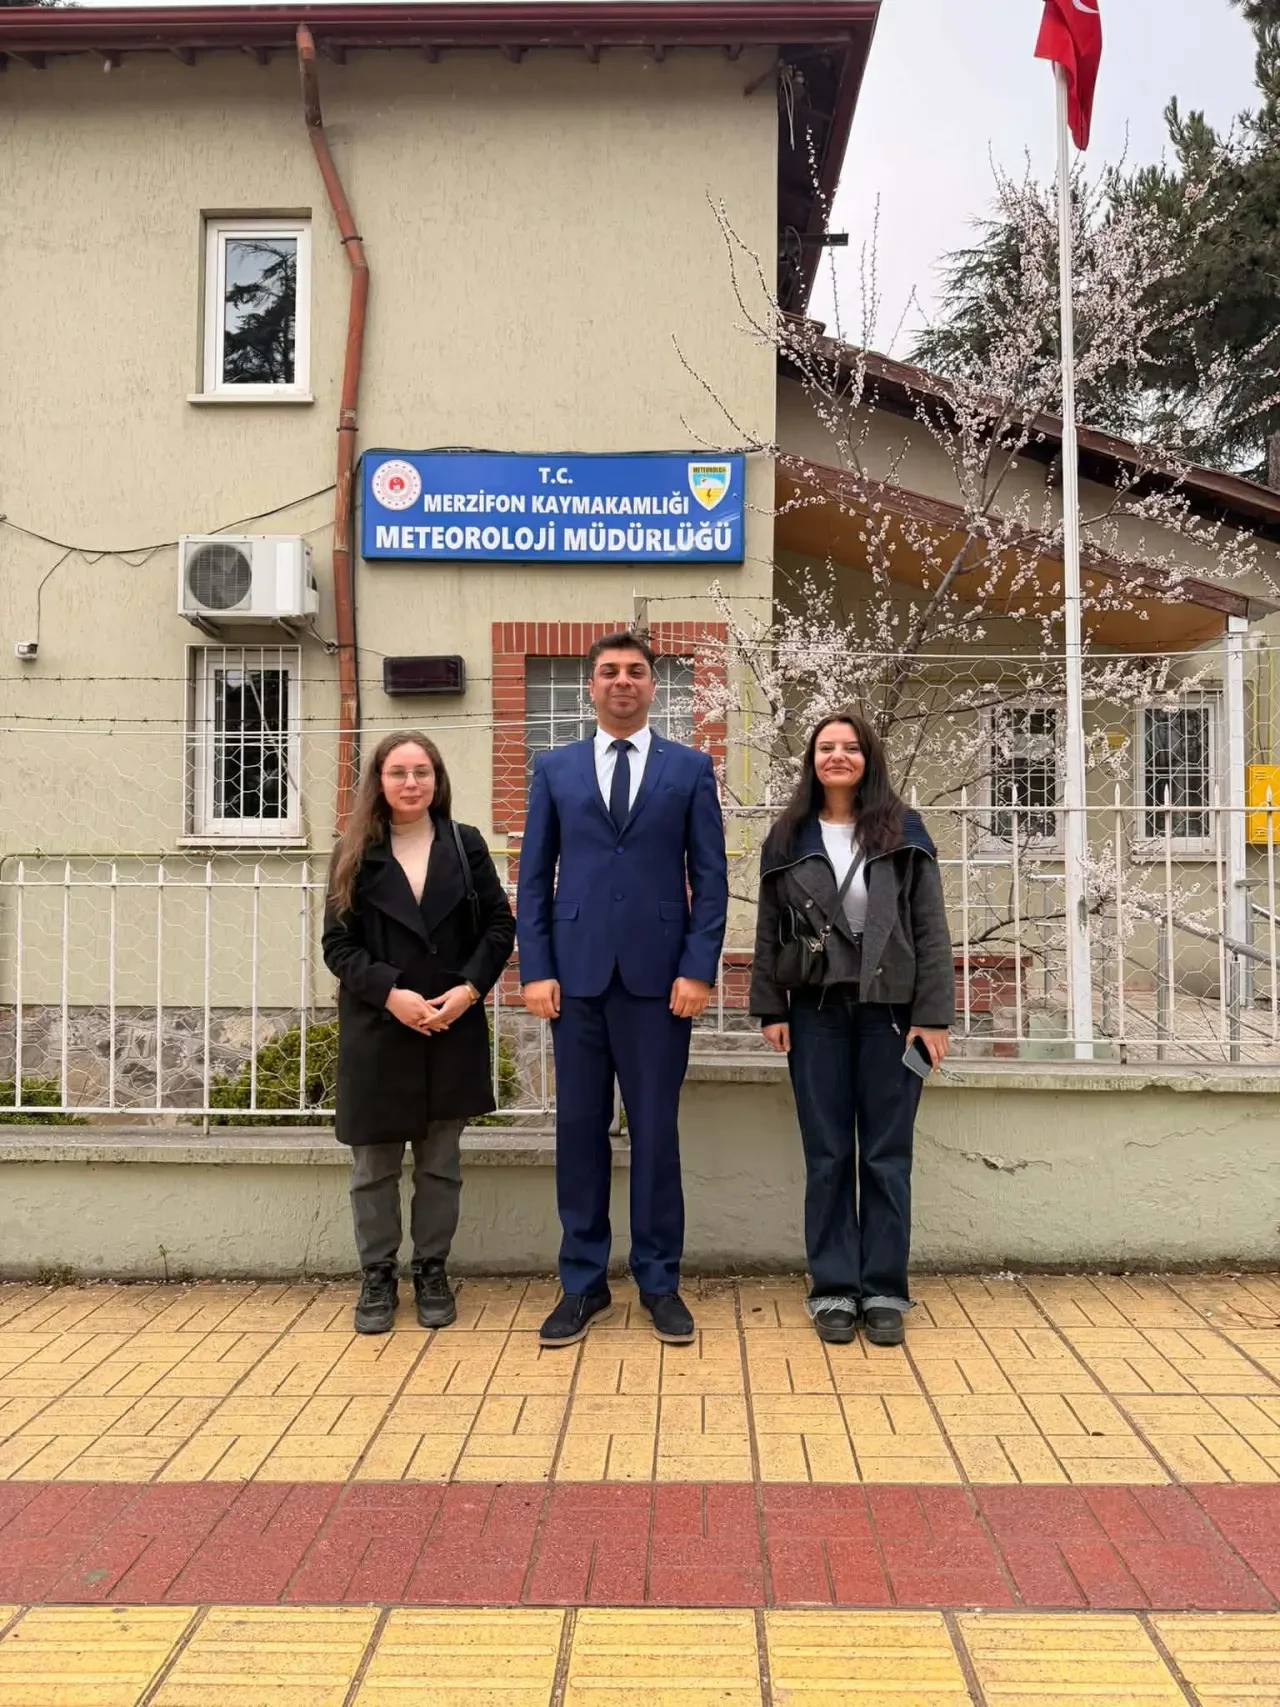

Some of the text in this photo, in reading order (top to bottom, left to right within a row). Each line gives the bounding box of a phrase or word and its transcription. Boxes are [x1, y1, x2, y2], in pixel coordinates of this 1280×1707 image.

[539, 467, 573, 484] T.C.
[424, 490, 688, 514] MERZİFON KAYMAKAMLIĞI
[376, 521, 731, 551] METEOROLOJİ MÜDÜRLÜĞÜ
